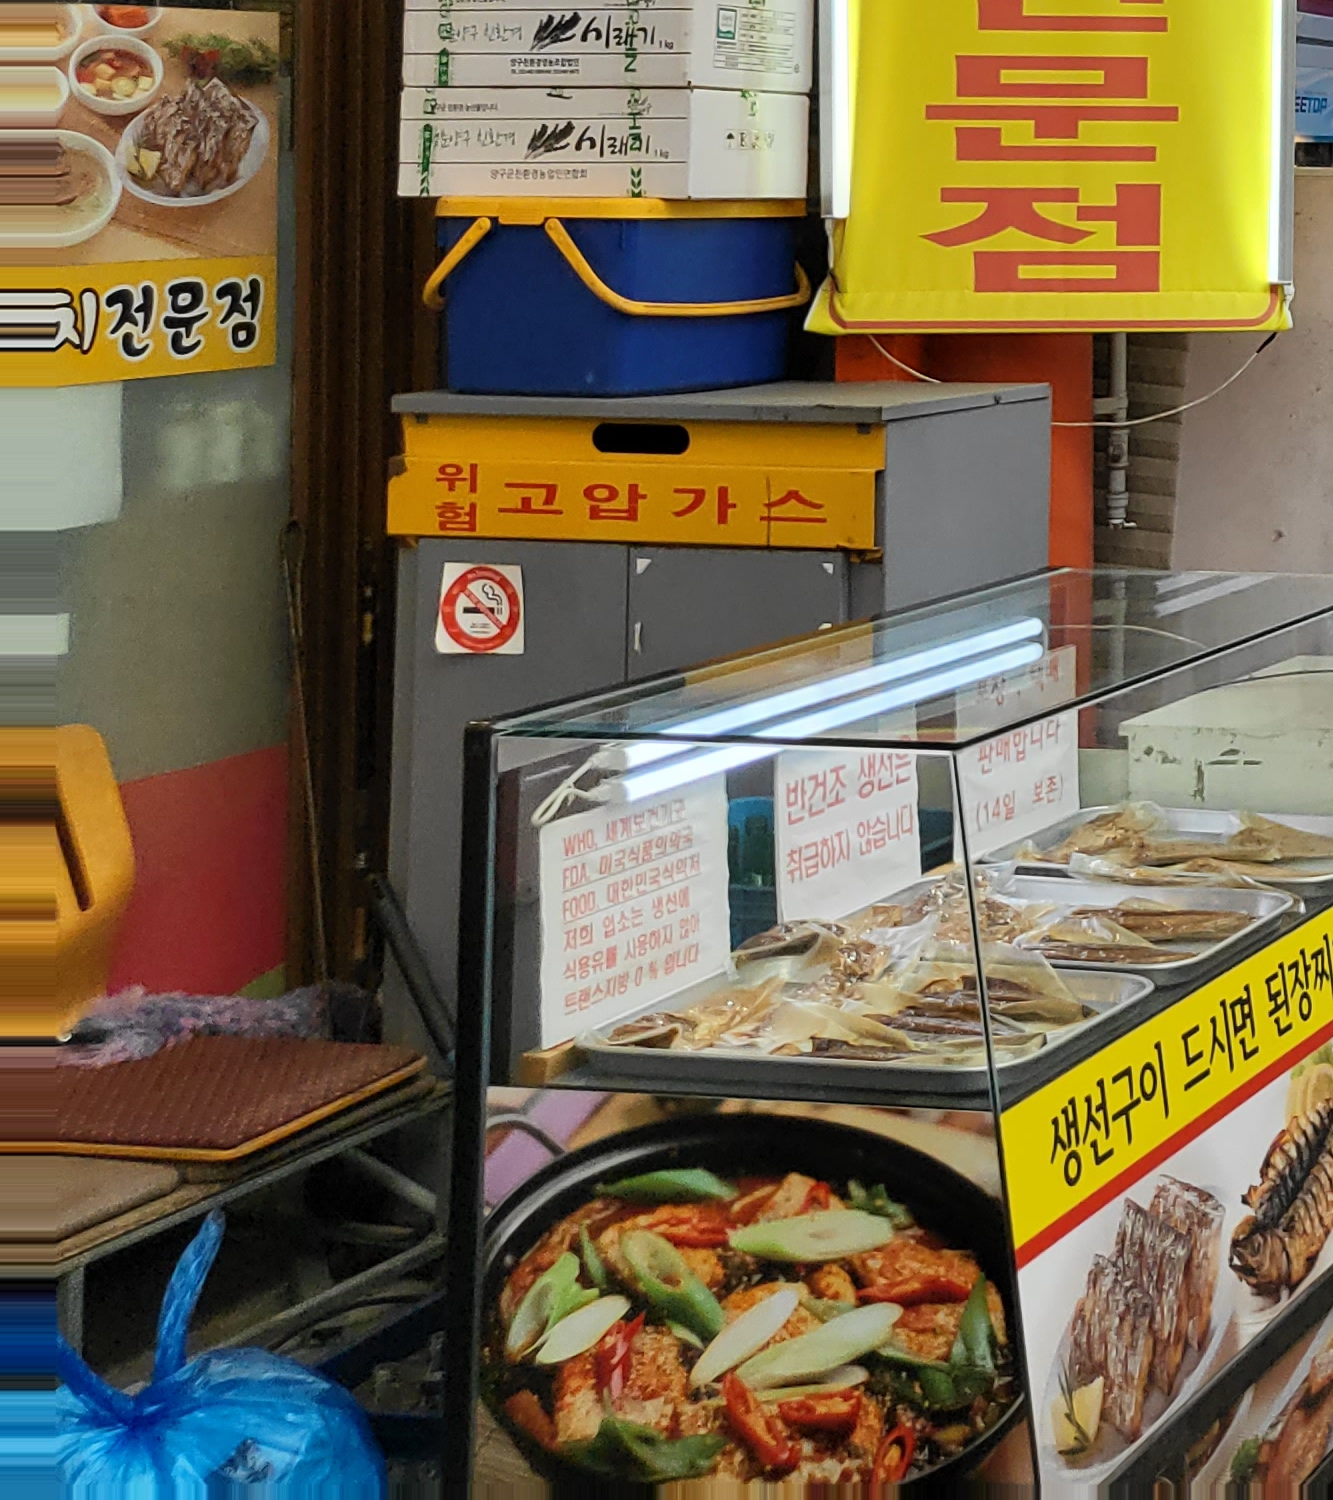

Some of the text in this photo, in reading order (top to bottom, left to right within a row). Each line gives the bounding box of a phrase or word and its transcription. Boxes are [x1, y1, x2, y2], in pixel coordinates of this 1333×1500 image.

[105, 276, 264, 360] 전문점
[435, 462, 479, 531] 위험
[497, 479, 827, 526] 고압가스
[785, 752, 913, 826] 반건조 생선은
[785, 803, 915, 884] 취급하지 않습니다
[563, 922, 593, 952] 저희
[1050, 1040, 1168, 1190] 생선구이
[1182, 991, 1259, 1094] 드시면
